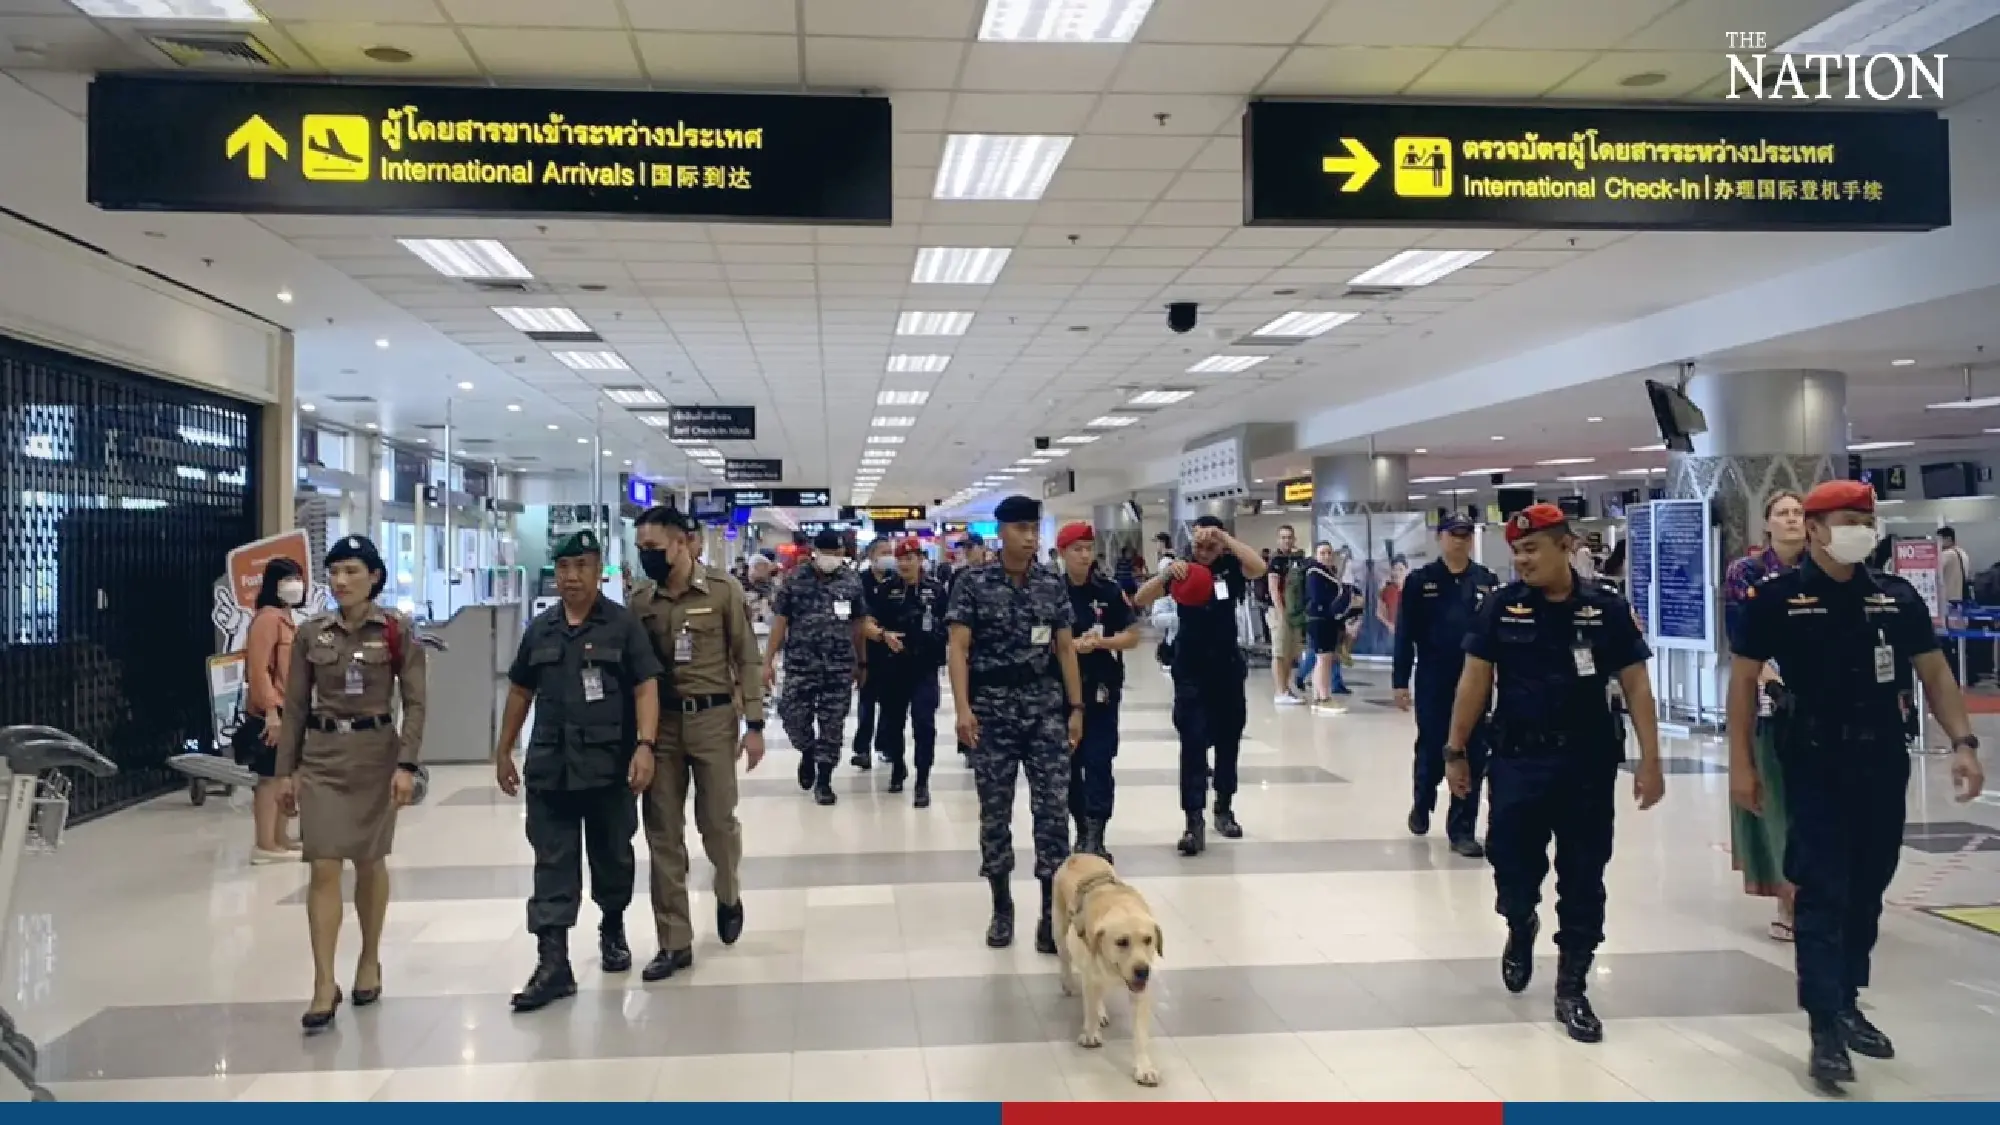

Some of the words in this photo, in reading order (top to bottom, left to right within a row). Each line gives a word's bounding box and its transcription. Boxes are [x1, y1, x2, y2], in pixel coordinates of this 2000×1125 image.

[381, 104, 764, 151] ผู้โดยสารขาเข้าระหว่างประเทศ
[1462, 128, 1835, 171] ตรวจบัตรผู้โดยสารระหว่างประเทศ
[381, 156, 533, 184] International
[542, 160, 635, 187] Arrivals
[651, 162, 752, 190] 国际到达
[1463, 174, 1596, 199] International
[1604, 176, 1700, 201] Check-In
[1714, 178, 1884, 202] 办理国际登机手续
